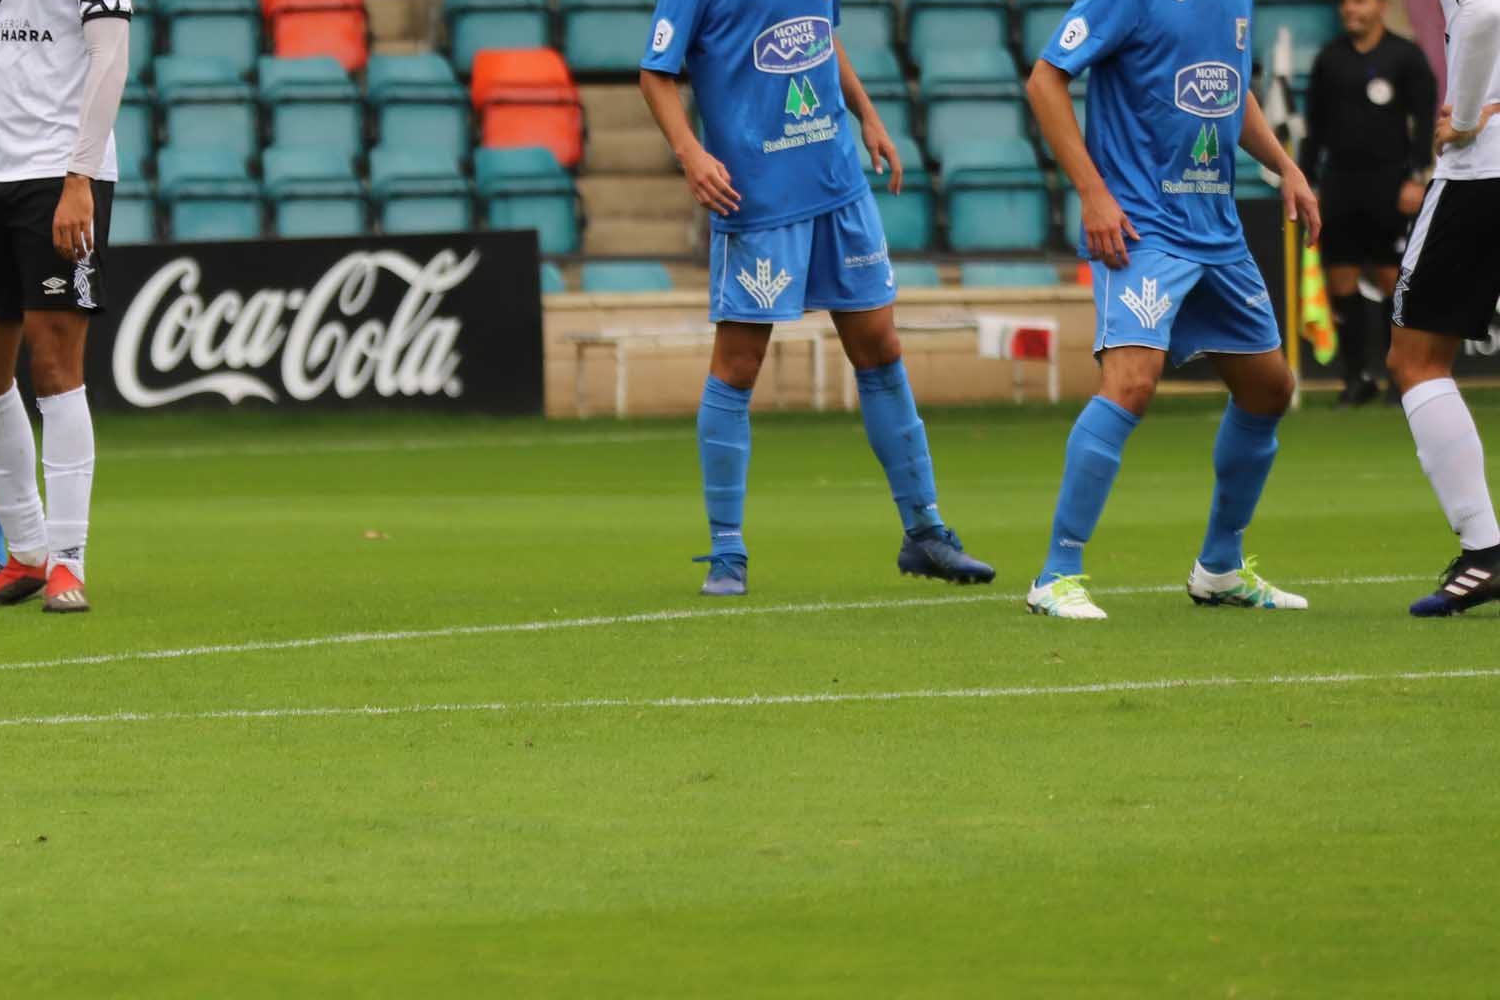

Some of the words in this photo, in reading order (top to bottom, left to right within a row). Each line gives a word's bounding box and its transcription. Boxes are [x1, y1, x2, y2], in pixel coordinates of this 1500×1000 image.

[773, 21, 814, 39] MONTE
[780, 31, 816, 48] PINOS
[1196, 68, 1228, 79] MONTE
[1200, 80, 1229, 91] PINOS
[112, 247, 481, 407] Coca-Cola
